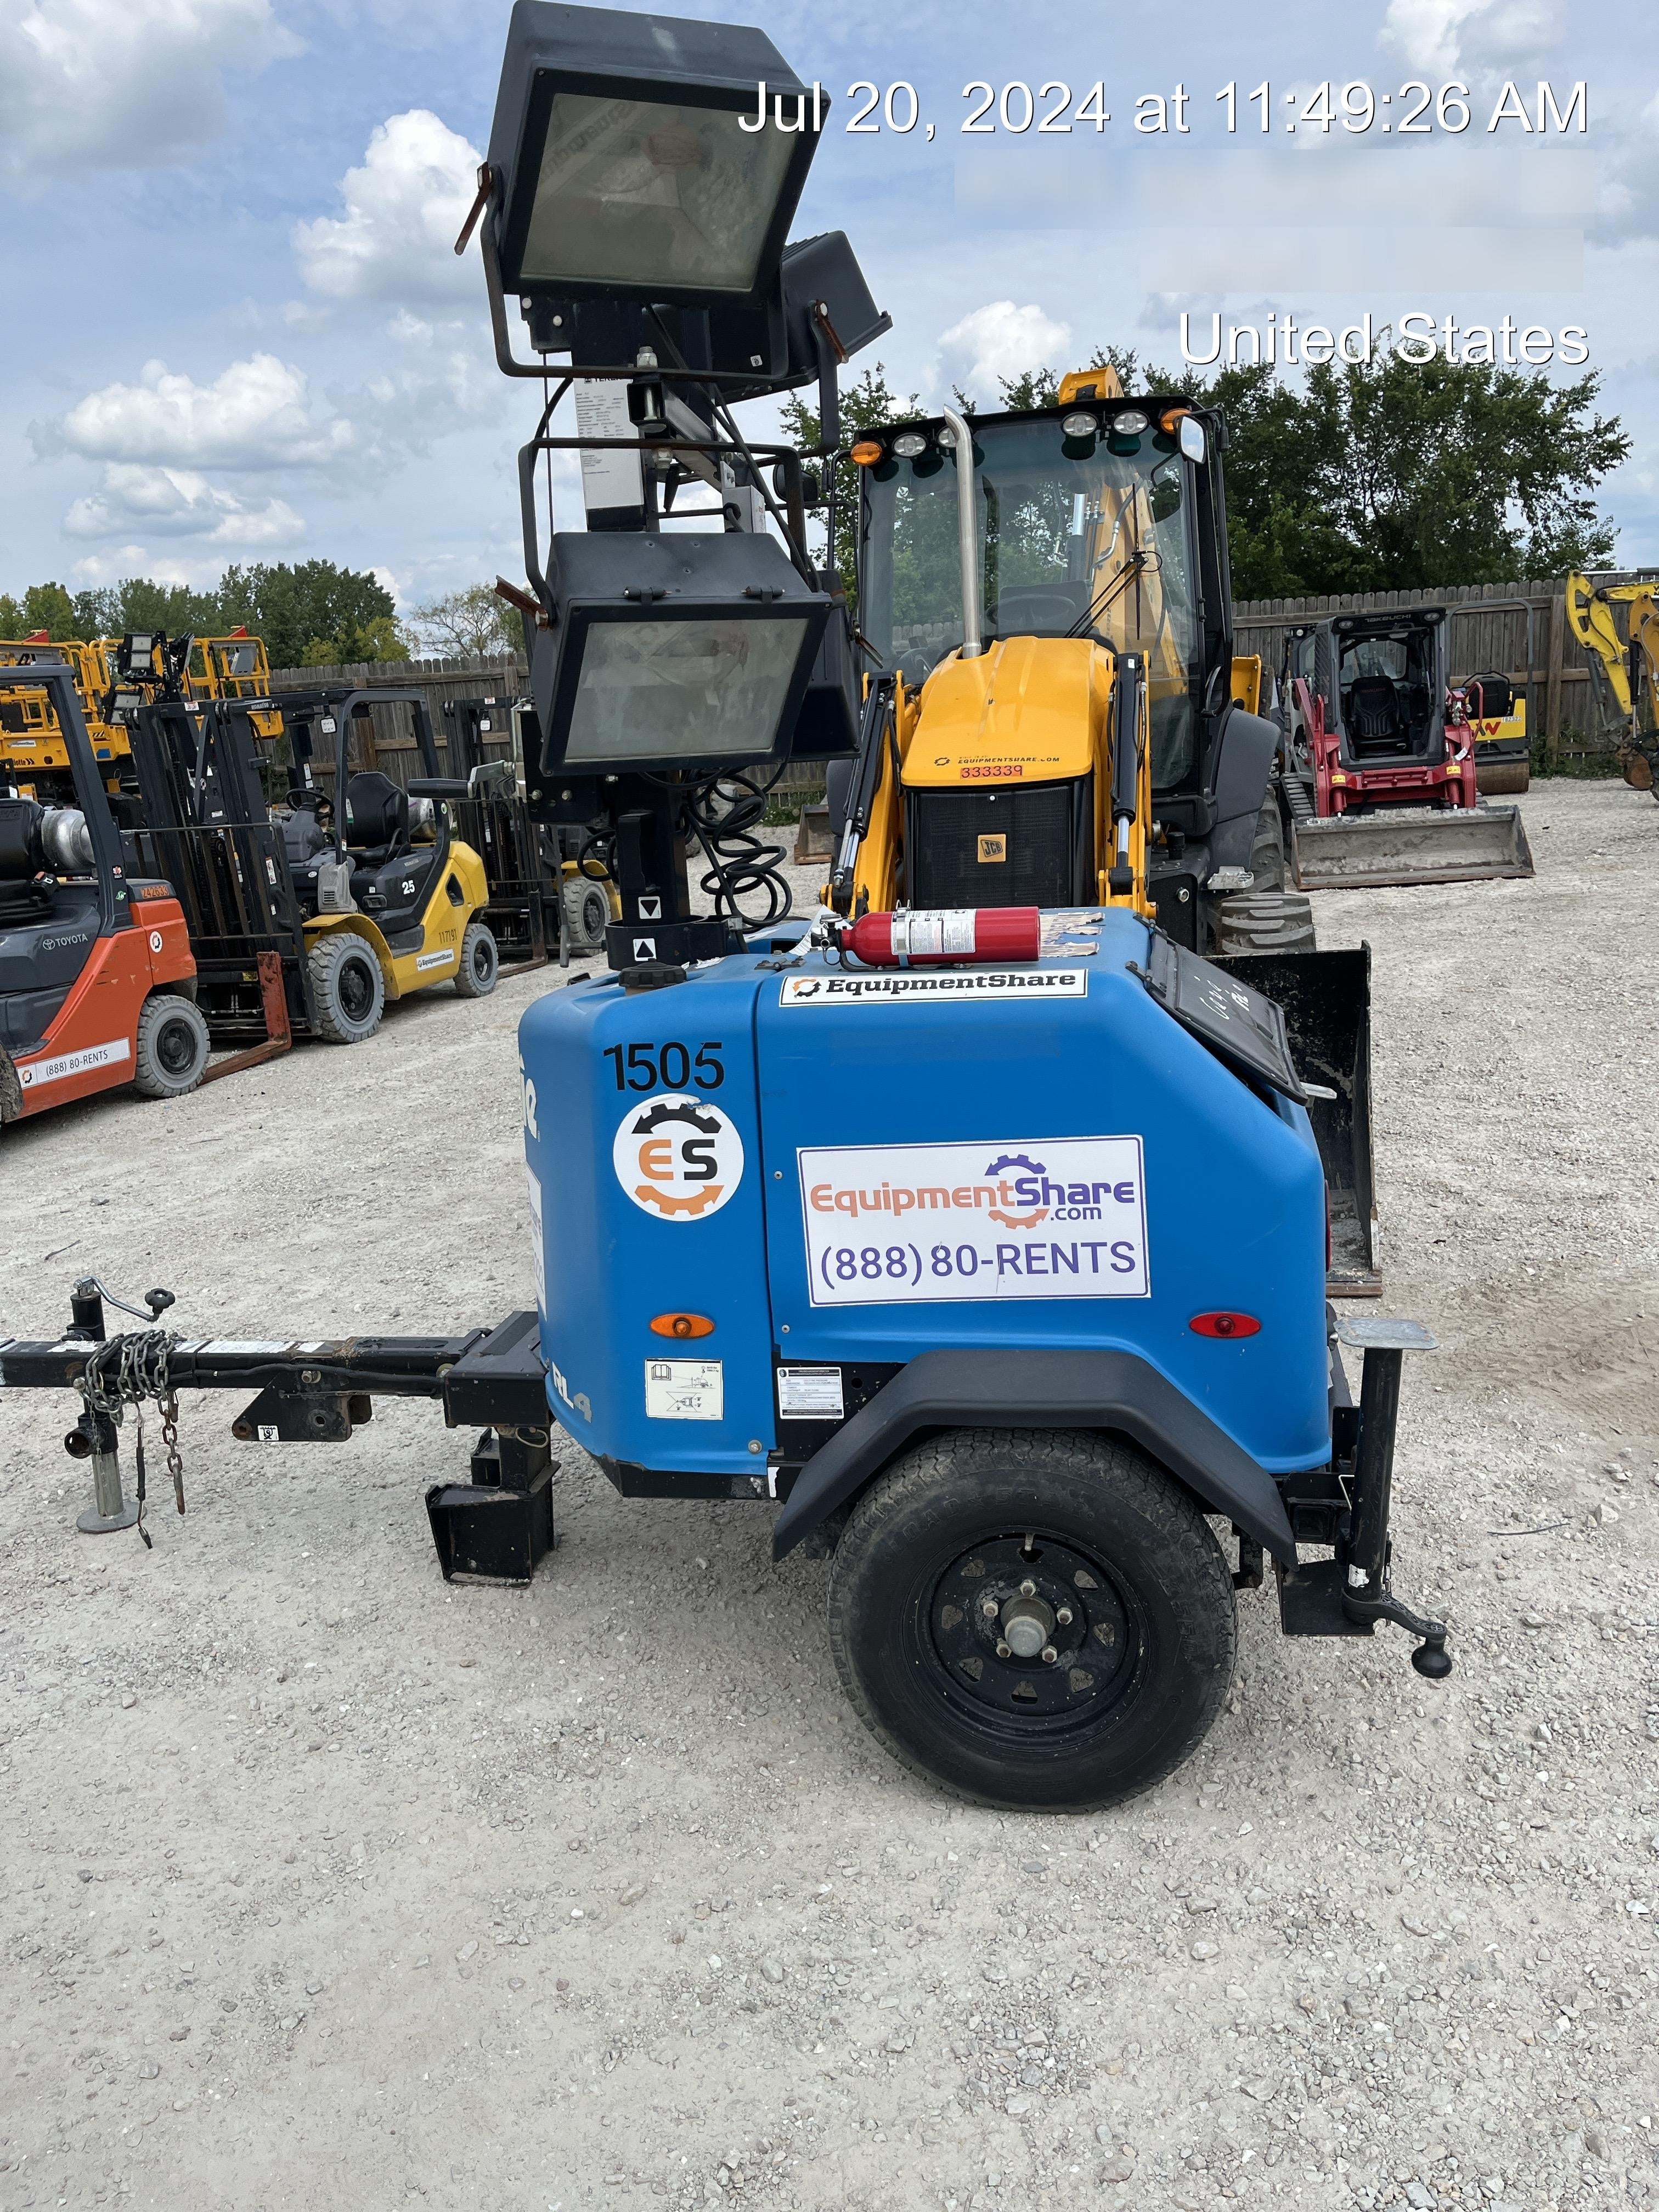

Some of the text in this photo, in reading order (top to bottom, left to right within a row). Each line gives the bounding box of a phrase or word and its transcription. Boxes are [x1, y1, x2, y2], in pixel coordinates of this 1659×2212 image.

[961, 765, 1023, 778] 333339
[984, 840, 1002, 856] JCB
[142, 885, 169, 899] 242633
[402, 880, 415, 895] 25
[55, 933, 88, 947] TOYOTA
[826, 973, 1076, 995] EquipmentShare
[46, 1049, 108, 1076] (888) 80-RENTS
[603, 1042, 724, 1091] 1505
[810, 1176, 1136, 1217] EquipmentShare
[1050, 1205, 1102, 1221] .com
[821, 1241, 1136, 1290] (888) 80-RENTS
